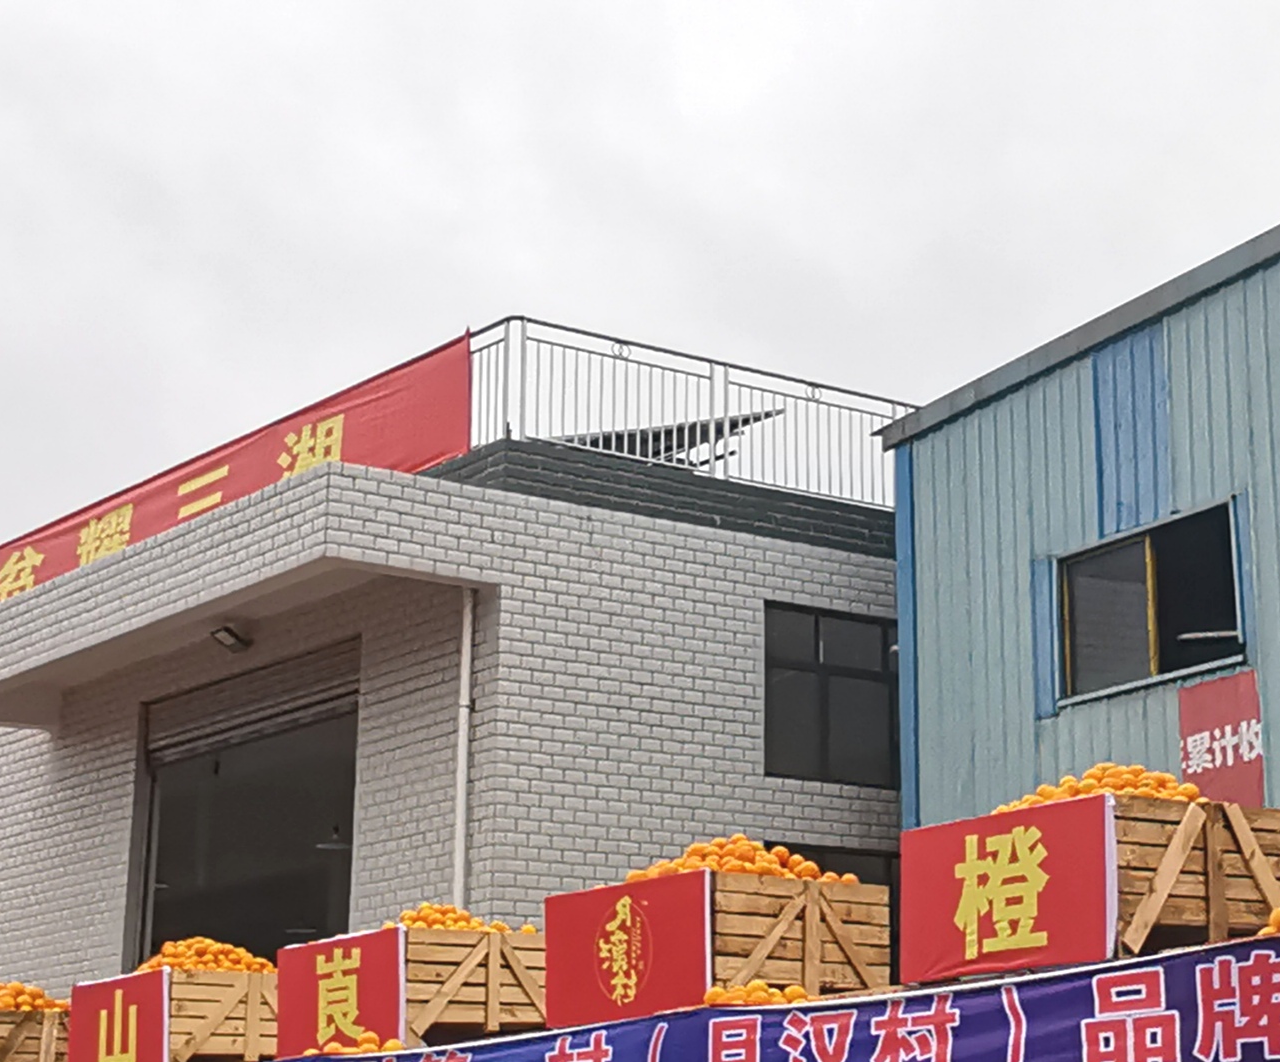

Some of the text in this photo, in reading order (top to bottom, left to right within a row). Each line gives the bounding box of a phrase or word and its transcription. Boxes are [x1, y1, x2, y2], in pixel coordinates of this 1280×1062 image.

[1179, 719, 1263, 774] 累计收
[953, 826, 1049, 960] 橙
[316, 946, 366, 1046] 崀
